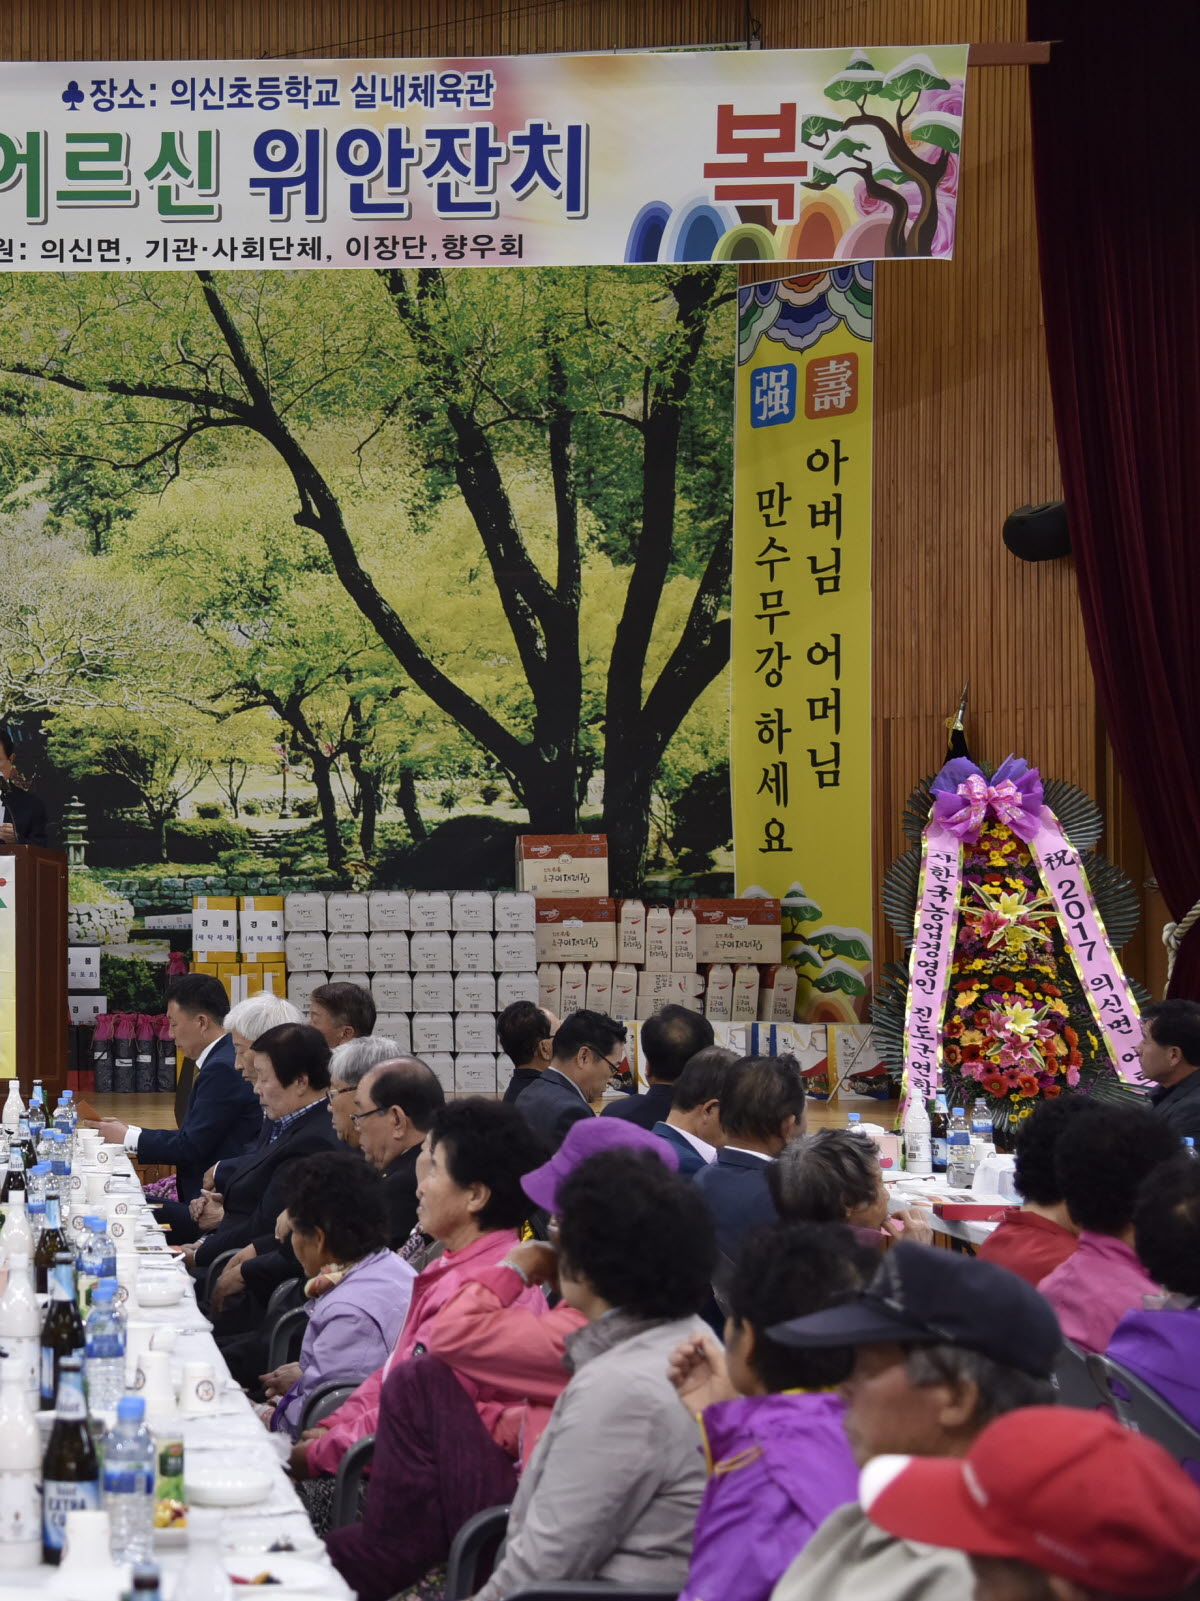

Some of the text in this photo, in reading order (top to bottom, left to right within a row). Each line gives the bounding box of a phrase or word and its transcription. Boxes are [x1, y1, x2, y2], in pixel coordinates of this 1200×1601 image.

[89, 73, 494, 110] 장소: 의신초등학교 실내체육관
[248, 123, 585, 216] 위안잔치
[703, 102, 808, 221] 복
[40, 237, 132, 265] 의신면,
[812, 360, 853, 412] 壽
[805, 438, 849, 790] 아버님 어머님
[754, 481, 794, 855] 만수무강 하세요
[1043, 849, 1133, 1035] 祝 2017 의신면
[907, 1006, 937, 1112] 진도군연합
